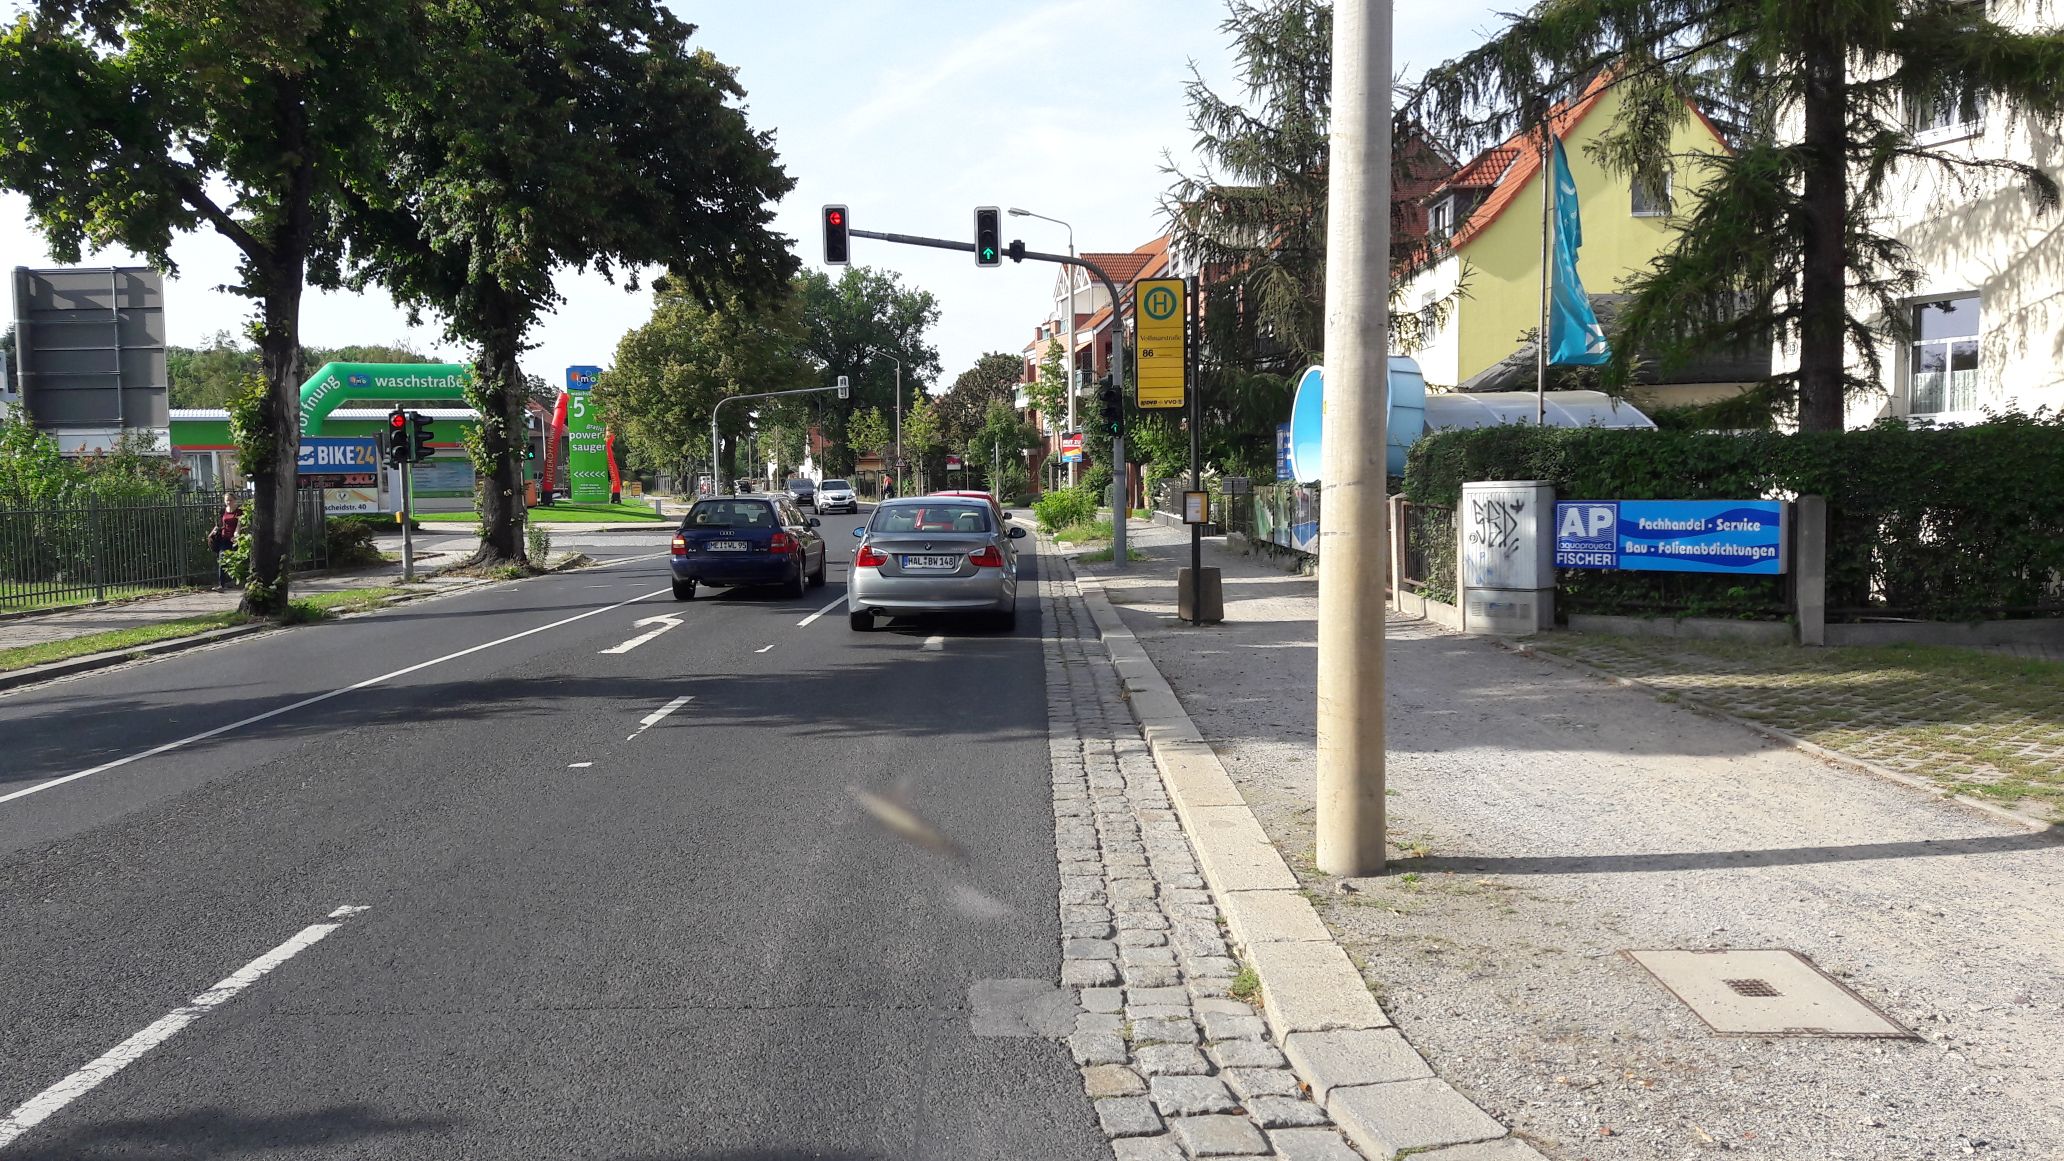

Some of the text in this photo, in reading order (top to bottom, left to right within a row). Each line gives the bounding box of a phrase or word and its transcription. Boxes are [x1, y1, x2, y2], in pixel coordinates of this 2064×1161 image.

[1153, 294, 1168, 313] H
[1142, 349, 1154, 358] 86
[375, 375, 464, 388] waschstraße
[317, 445, 376, 465] BIKE24
[572, 444, 606, 454] sauger
[324, 503, 357, 511] scheidstr.
[1560, 507, 1614, 537] AP
[1639, 517, 1761, 531] Fachhandel Service
[1625, 541, 1776, 560] Bau Folienabdichtungen
[908, 557, 954, 566] HAL BW 148
[1557, 553, 1612, 566] FISCHER
